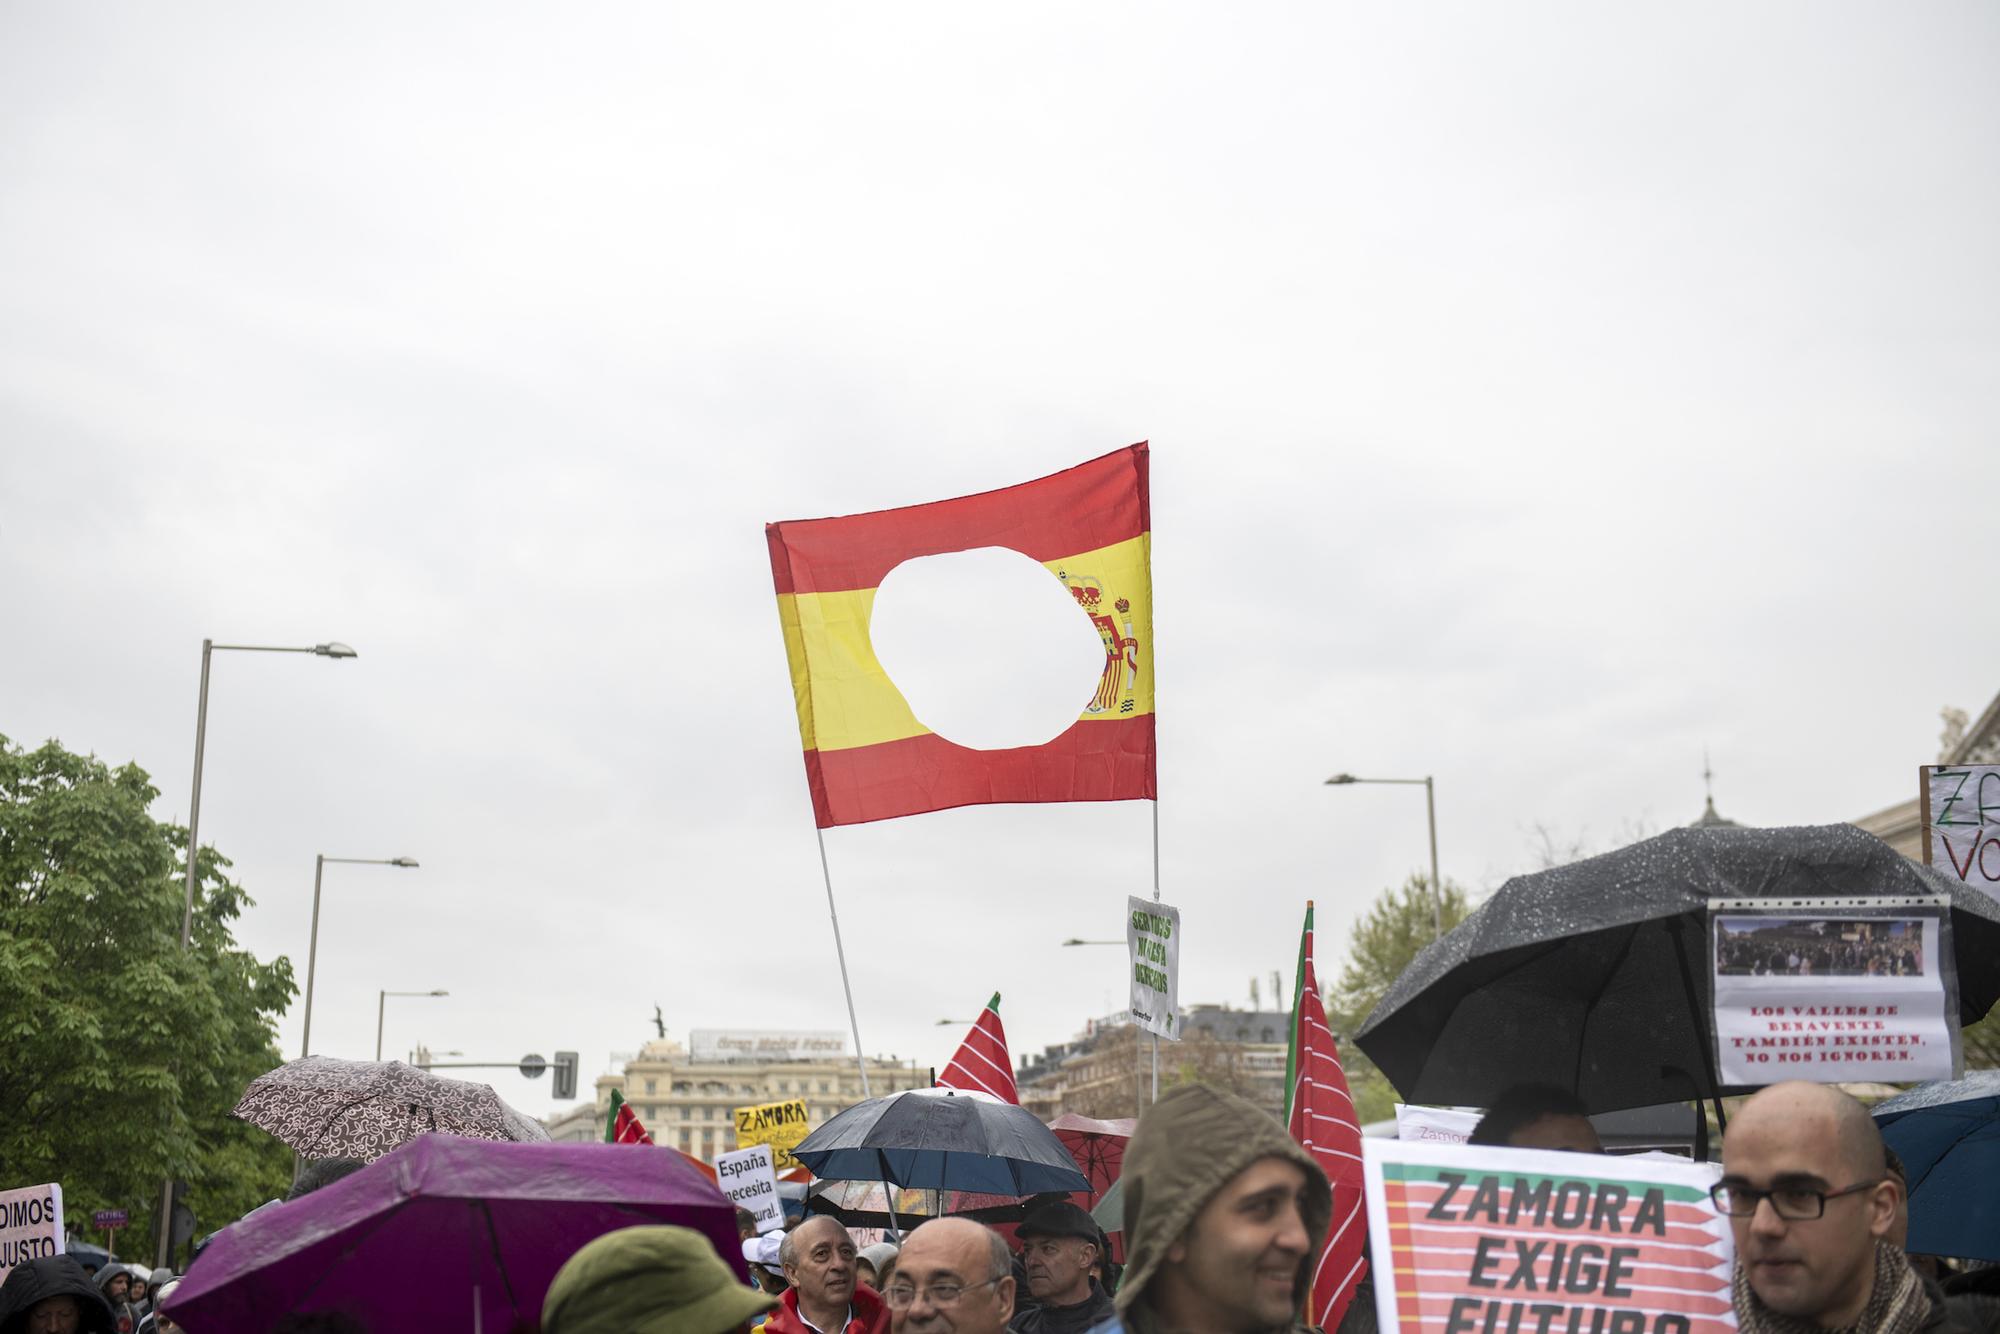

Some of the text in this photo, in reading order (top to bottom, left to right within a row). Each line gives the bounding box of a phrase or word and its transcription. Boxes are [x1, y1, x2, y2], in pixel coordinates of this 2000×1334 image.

[1750, 1006, 1898, 1017] LOS VALLES DE
[1768, 1021, 1885, 1032] BENAVENTE
[1731, 1033, 1926, 1048] TAMBIÉN EXISTEN,
[1745, 1050, 1915, 1063] NO NOS IGNOREN.
[739, 1102, 807, 1132] ZAMORA
[719, 1153, 767, 1178] España
[725, 1179, 773, 1202] necesita
[1426, 1172, 1666, 1236] ZAMORA
[0, 1236, 56, 1269] JUSTO
[1468, 1237, 1640, 1298] EXIGE
